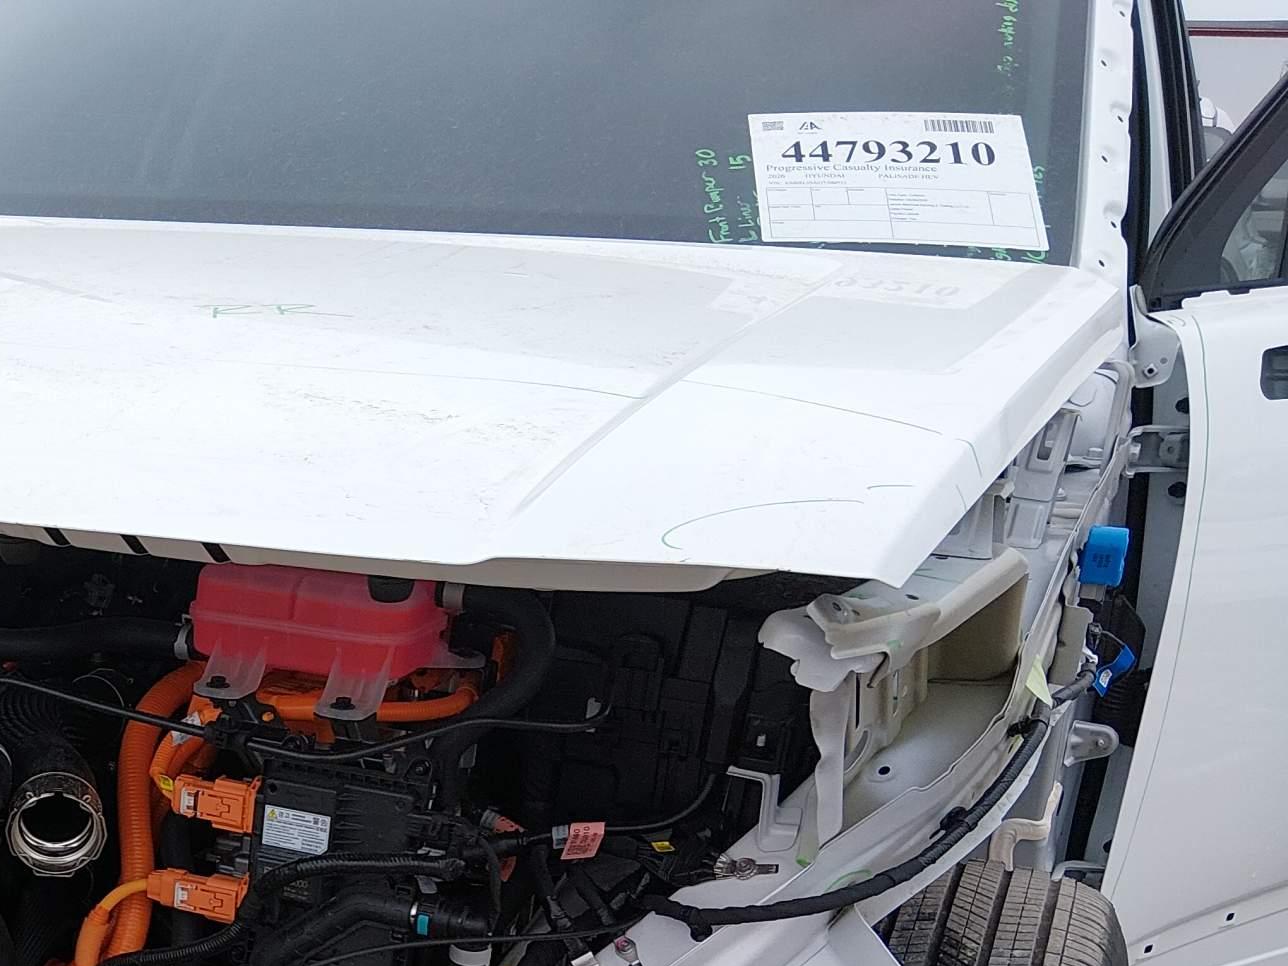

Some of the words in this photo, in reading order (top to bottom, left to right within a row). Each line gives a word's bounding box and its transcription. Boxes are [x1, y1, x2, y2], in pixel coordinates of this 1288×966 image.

[695, 148, 718, 167] 30
[781, 139, 996, 167] 44793210
[728, 154, 753, 170] 15
[766, 164, 830, 173] Progressive
[833, 164, 881, 173] Casualty
[884, 163, 937, 173] Insurance
